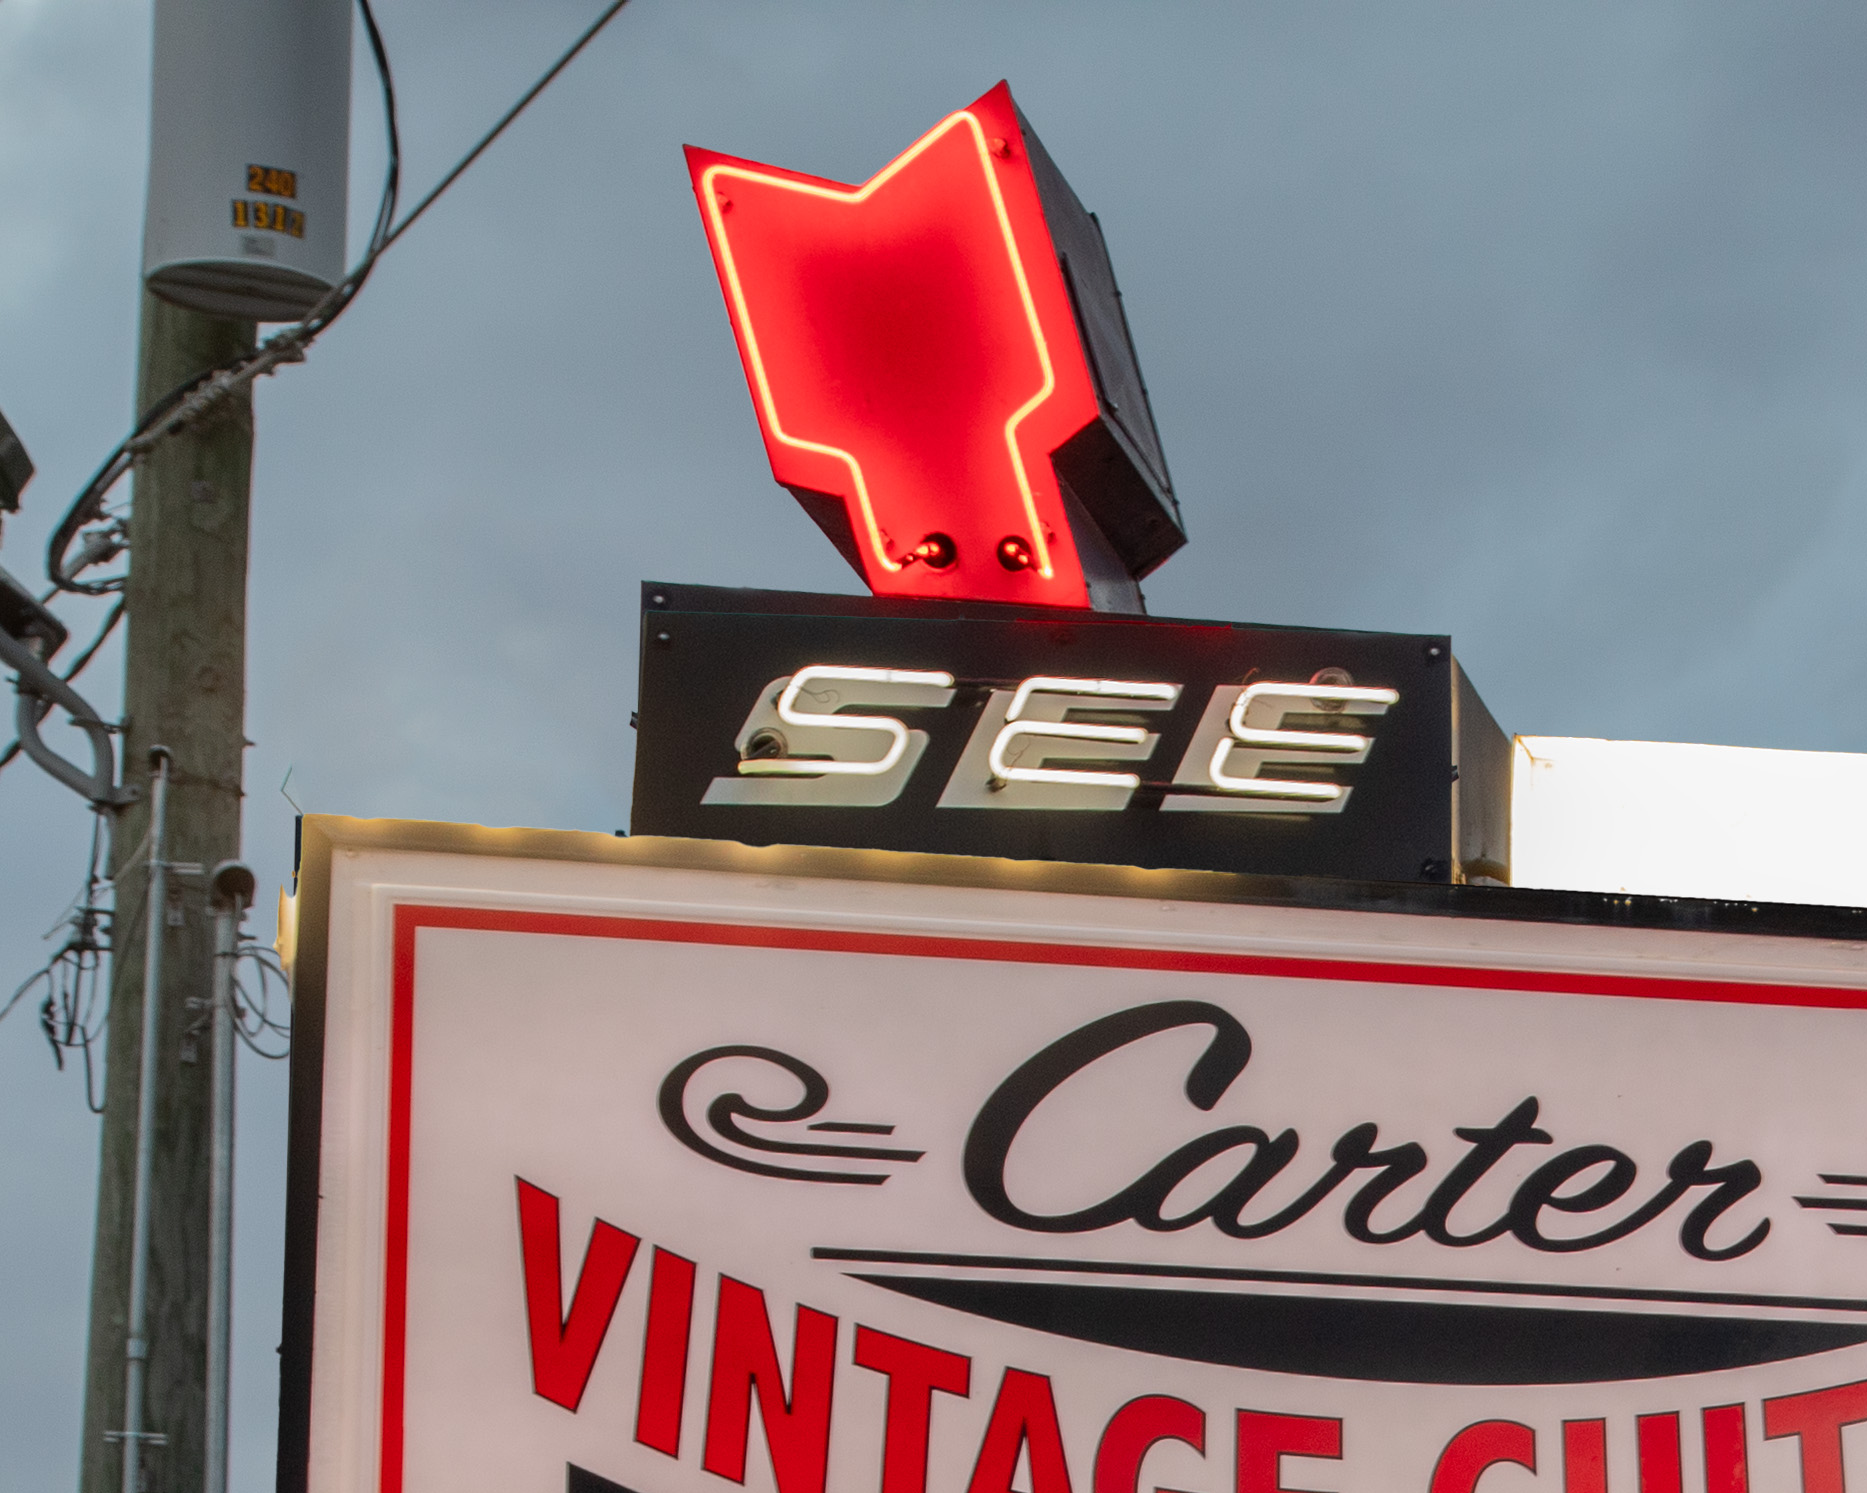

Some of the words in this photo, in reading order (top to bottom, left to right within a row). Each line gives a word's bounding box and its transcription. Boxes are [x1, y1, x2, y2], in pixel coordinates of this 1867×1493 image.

[247, 165, 297, 198] 240
[700, 665, 1399, 813] SEE
[962, 1001, 1771, 1262] Carter
